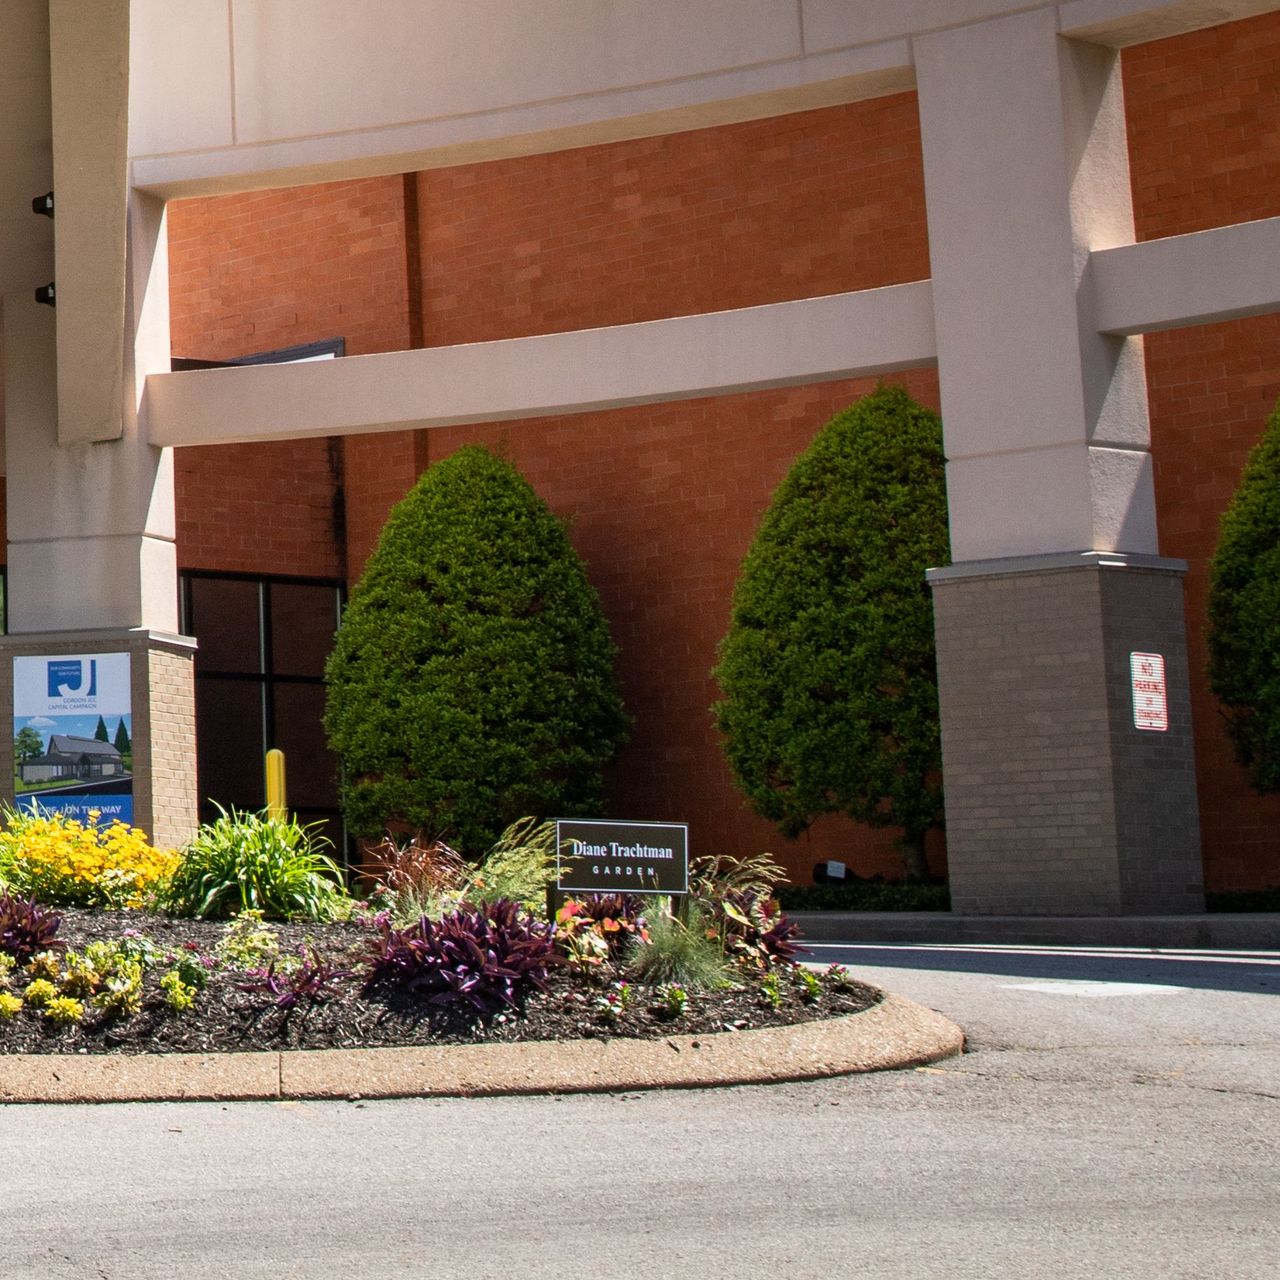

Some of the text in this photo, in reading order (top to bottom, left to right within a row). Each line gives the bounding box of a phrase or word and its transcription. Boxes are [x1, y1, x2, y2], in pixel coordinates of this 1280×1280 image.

[1141, 662, 1153, 677] NO
[1134, 679, 1162, 694] PARKING
[1137, 708, 1162, 721] STANDING
[101, 805, 122, 814] WAY
[573, 841, 673, 859] Diane Trachtman
[592, 865, 655, 876] GARDEN
